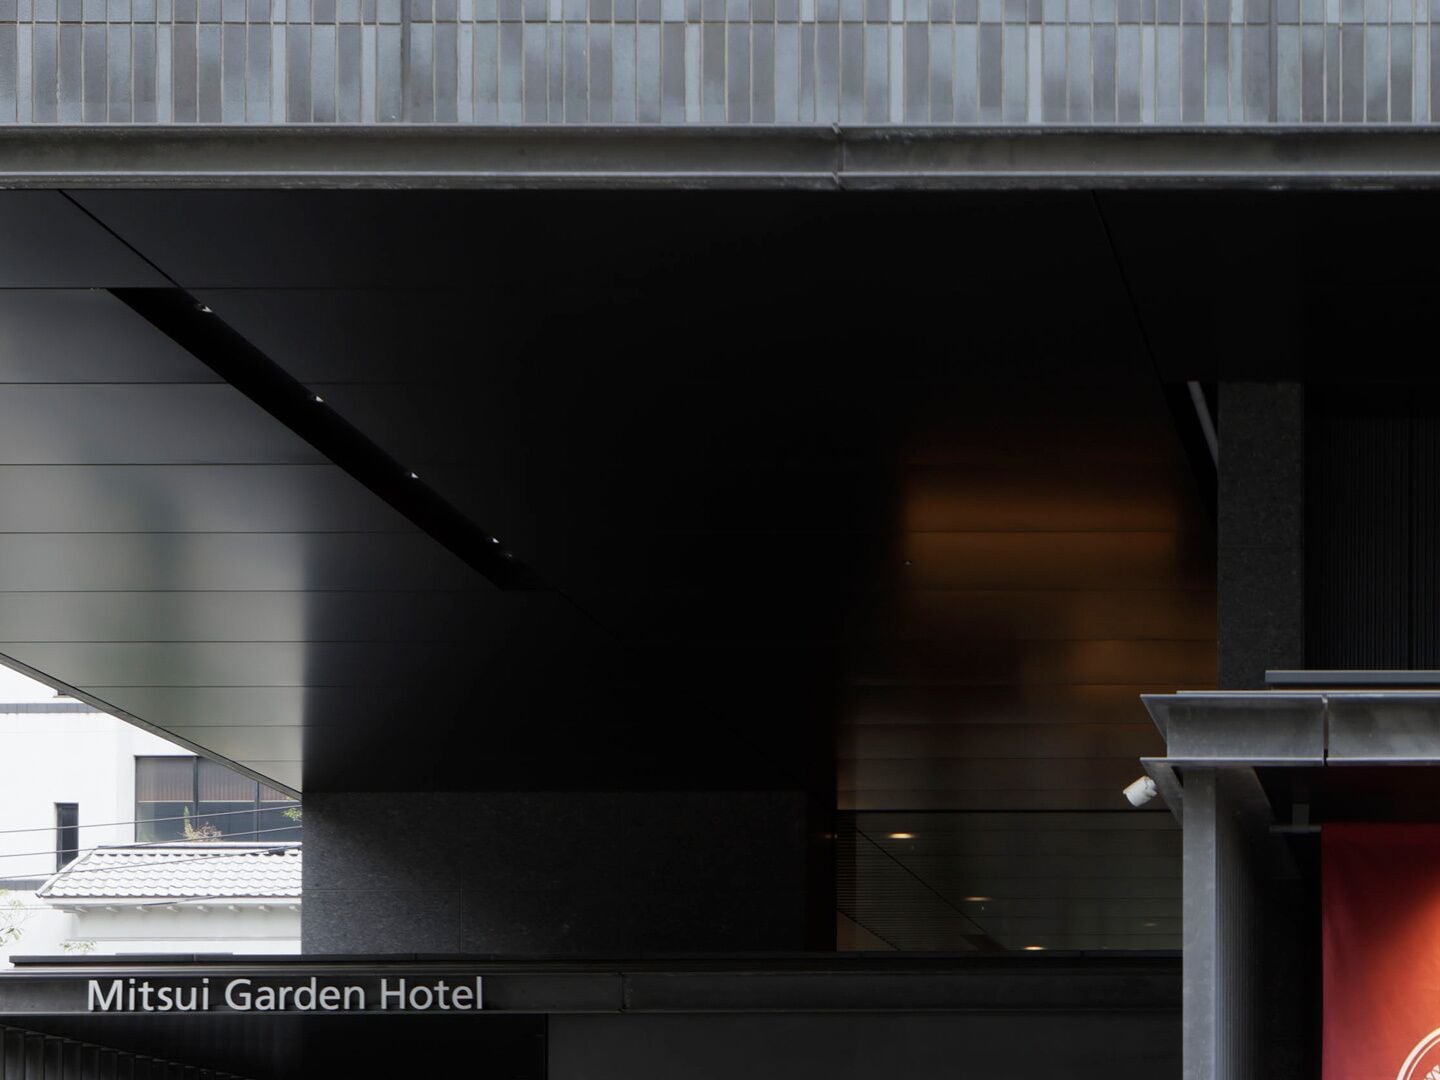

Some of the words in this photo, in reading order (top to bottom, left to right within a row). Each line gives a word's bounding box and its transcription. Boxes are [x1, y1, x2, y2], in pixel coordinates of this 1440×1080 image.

[87, 977, 209, 1011] Mitsui
[224, 976, 366, 1011] Garden
[380, 976, 482, 1011] Hotel
